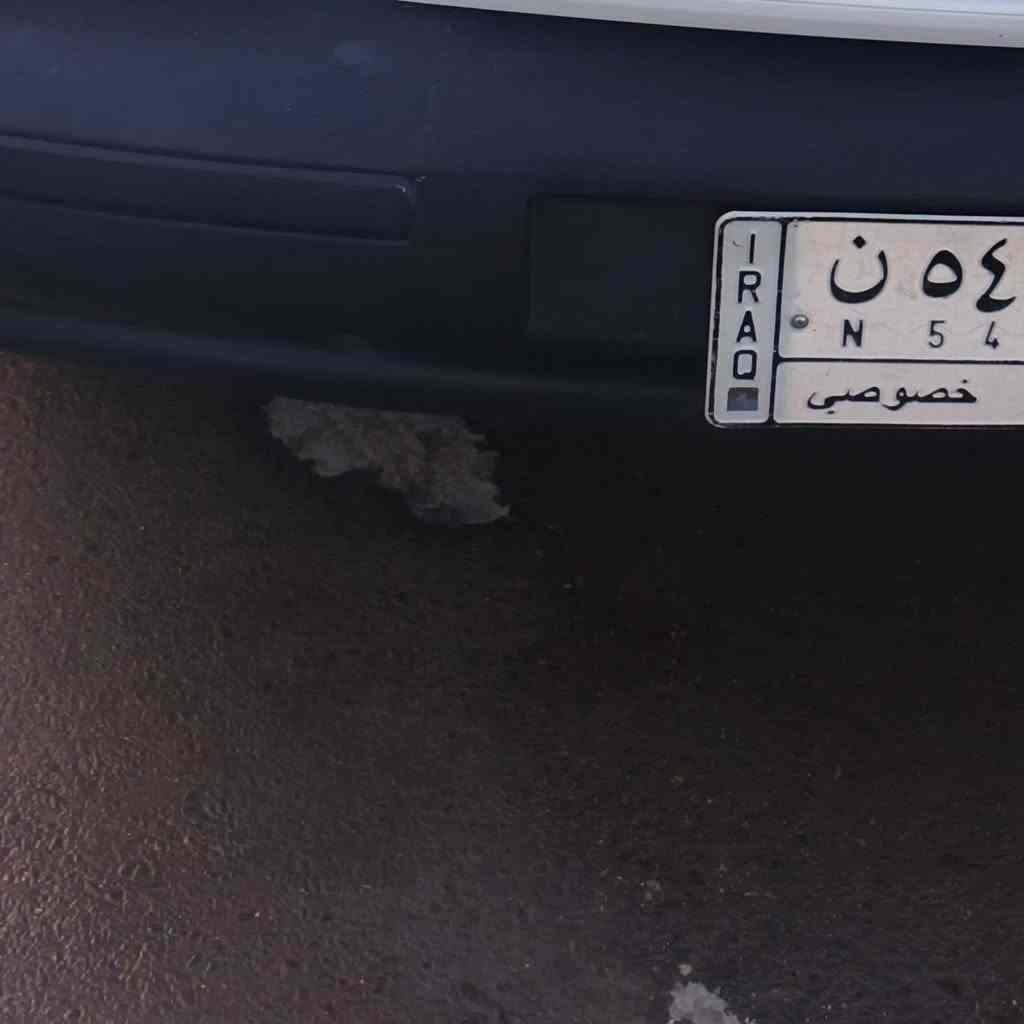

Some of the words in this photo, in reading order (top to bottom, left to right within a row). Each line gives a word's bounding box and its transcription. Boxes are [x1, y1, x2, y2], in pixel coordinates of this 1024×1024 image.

[829, 235, 888, 304] ن
[733, 233, 762, 381] IRAQ
[842, 319, 863, 348] N
[806, 378, 977, 414] خصوصي
